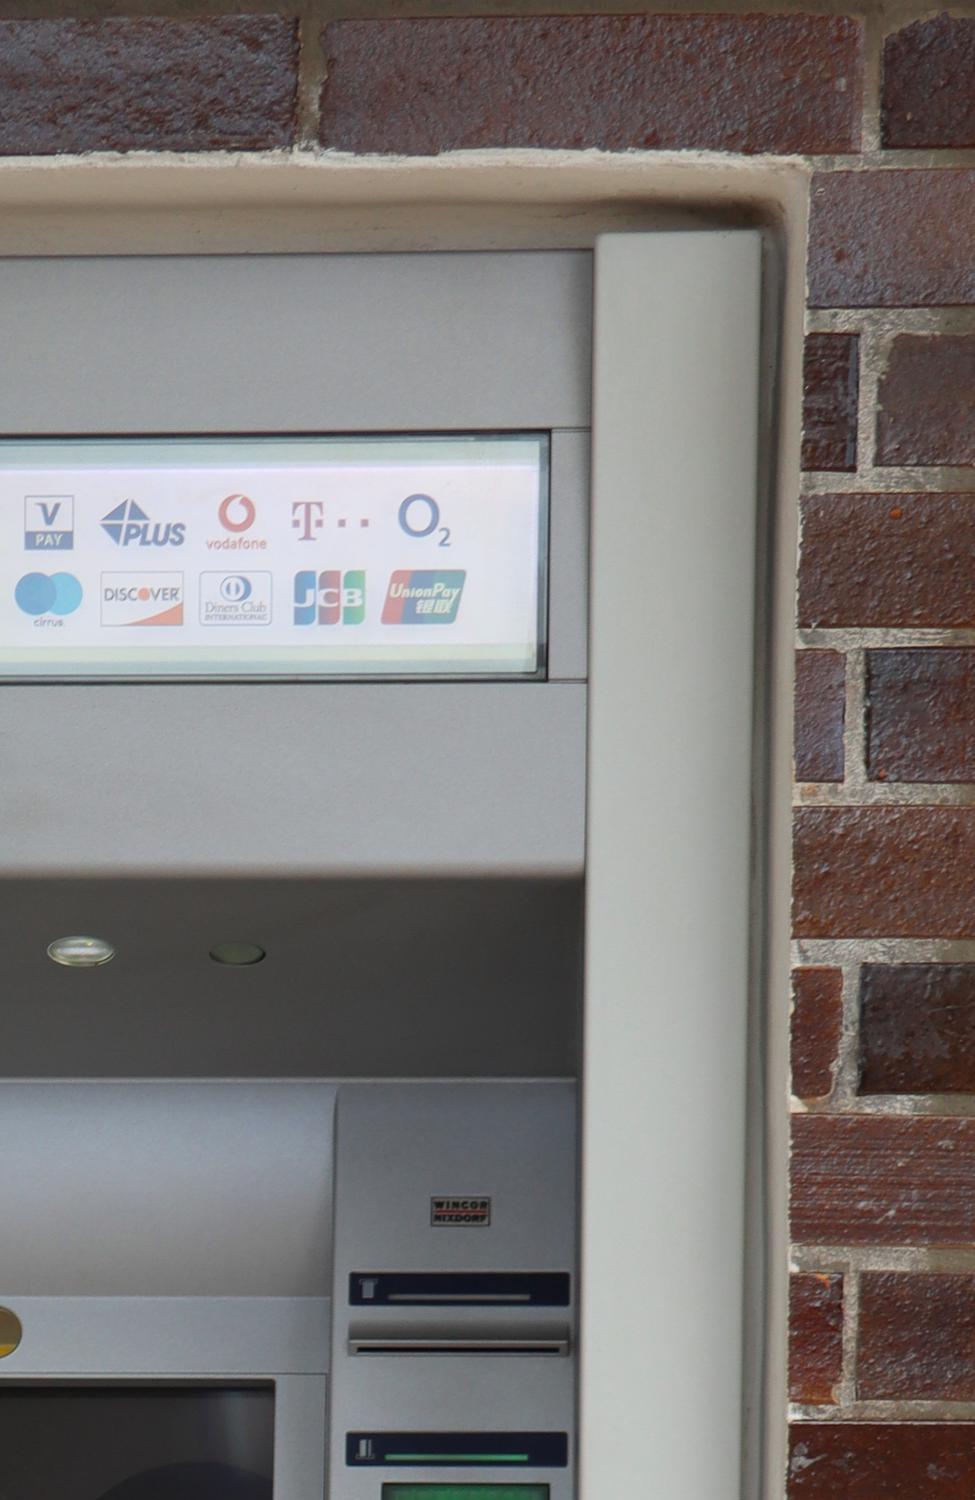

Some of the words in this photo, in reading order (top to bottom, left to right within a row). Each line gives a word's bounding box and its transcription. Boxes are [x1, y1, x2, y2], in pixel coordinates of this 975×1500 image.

[35, 502, 61, 526] V
[35, 533, 61, 546] PAY
[124, 522, 186, 547] PLUS
[206, 537, 268, 551] vodafone
[104, 586, 180, 602] DISCOVER
[294, 588, 363, 608] JCB
[390, 582, 461, 603] UnionPay
[204, 601, 237, 613] Diners
[241, 601, 267, 613] Club
[33, 616, 64, 628] cirrus
[204, 613, 268, 622] INTERNATIONAL
[433, 1199, 488, 1210] WINCOR
[433, 1213, 488, 1223] NIXDORF
